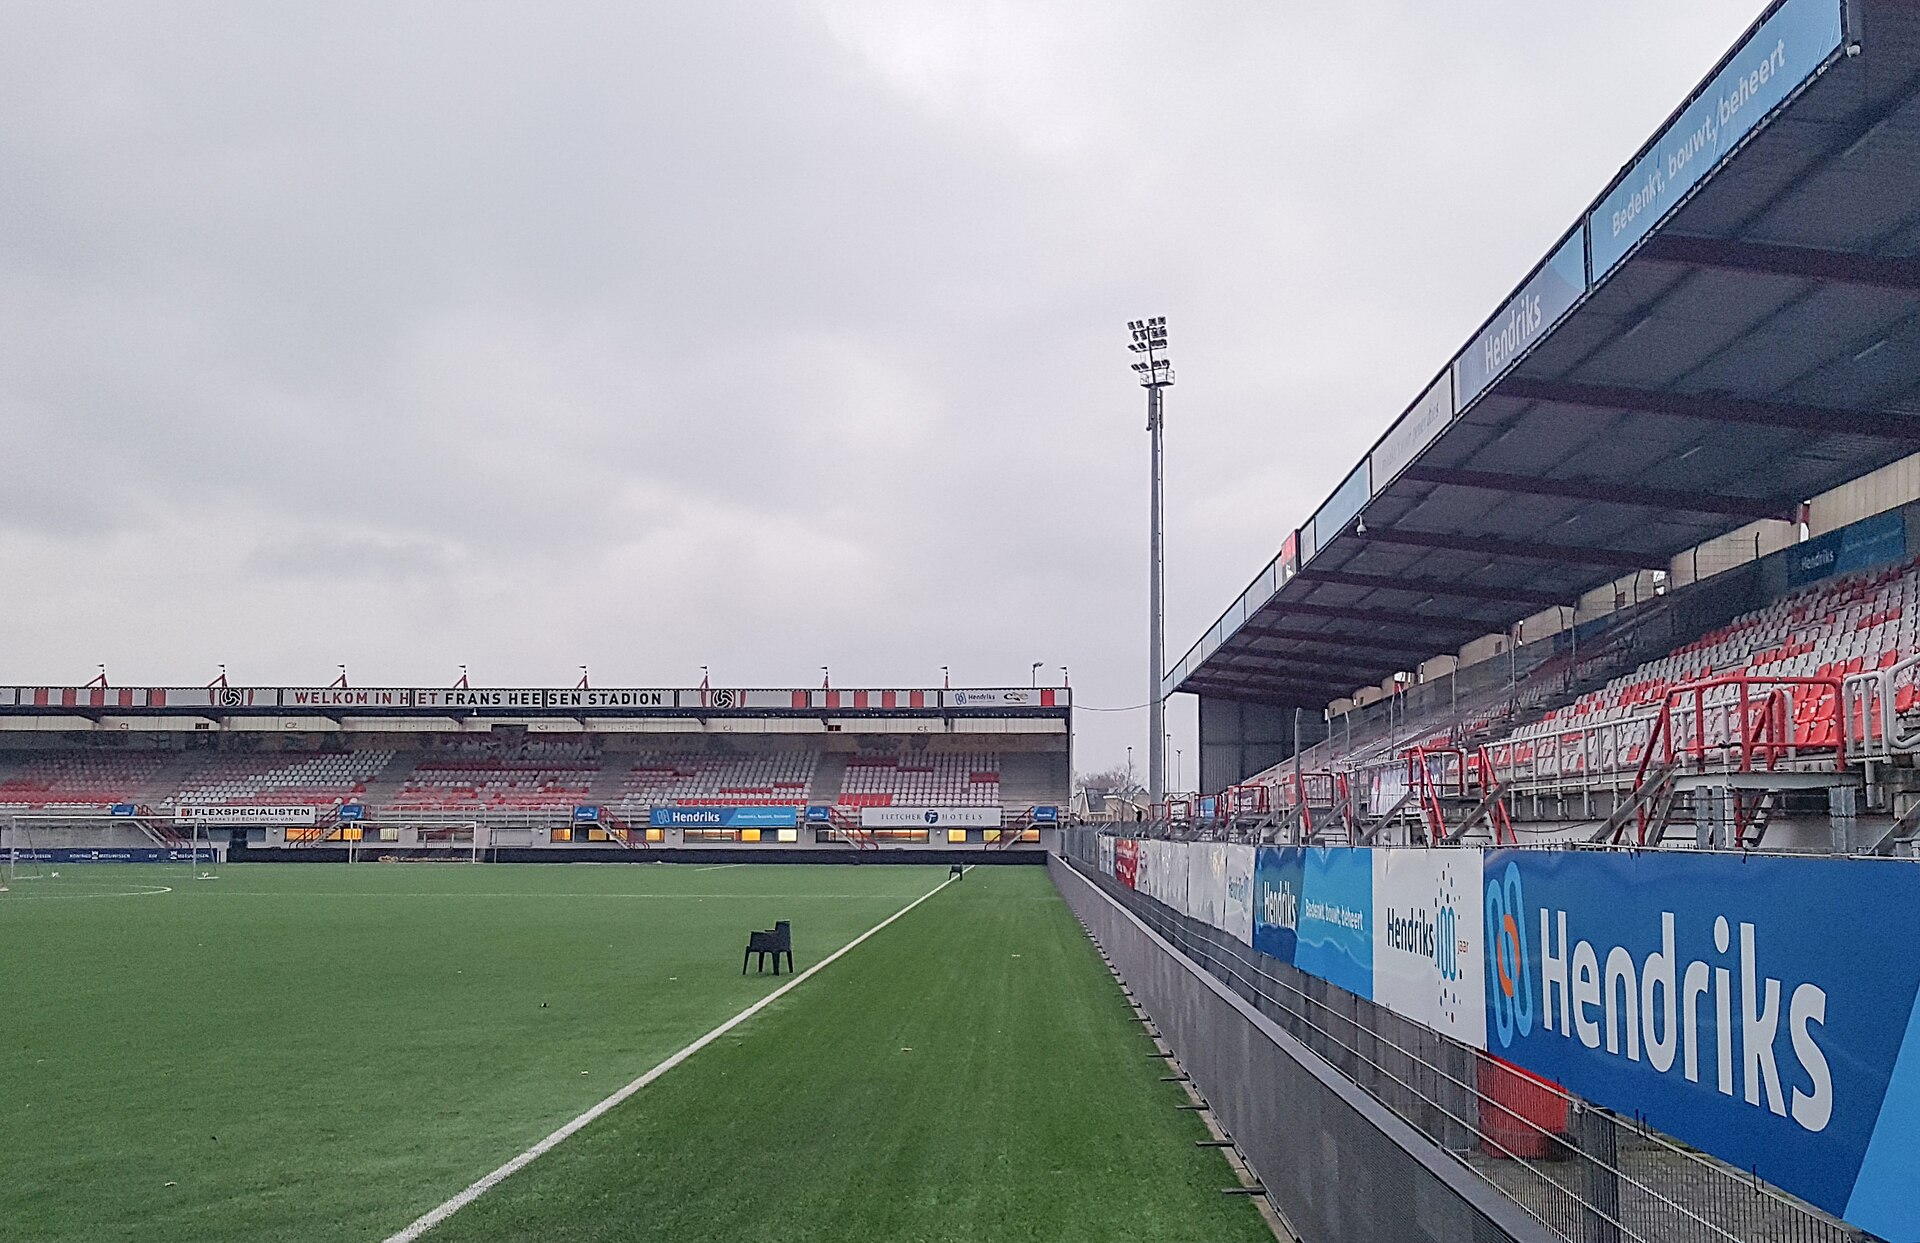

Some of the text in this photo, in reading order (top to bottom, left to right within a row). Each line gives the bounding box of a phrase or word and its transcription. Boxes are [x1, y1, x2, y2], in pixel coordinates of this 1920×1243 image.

[1613, 38, 1786, 238] Bedenkt, bouwt, beheert
[1484, 294, 1542, 375] Hendriks
[294, 692, 368, 705] WELKOM
[375, 692, 393, 705] IN
[445, 692, 501, 705] FRANS
[588, 692, 662, 705] STADION
[194, 808, 310, 816] FLEXSPECIALISTEN
[672, 811, 721, 823] Hendriks
[1263, 880, 1297, 930] Hendriks
[1341, 904, 1364, 931] beheert
[1387, 907, 1435, 959] Hendriks
[1457, 939, 1470, 955] jaar
[1540, 907, 1834, 1133] Hendriks
